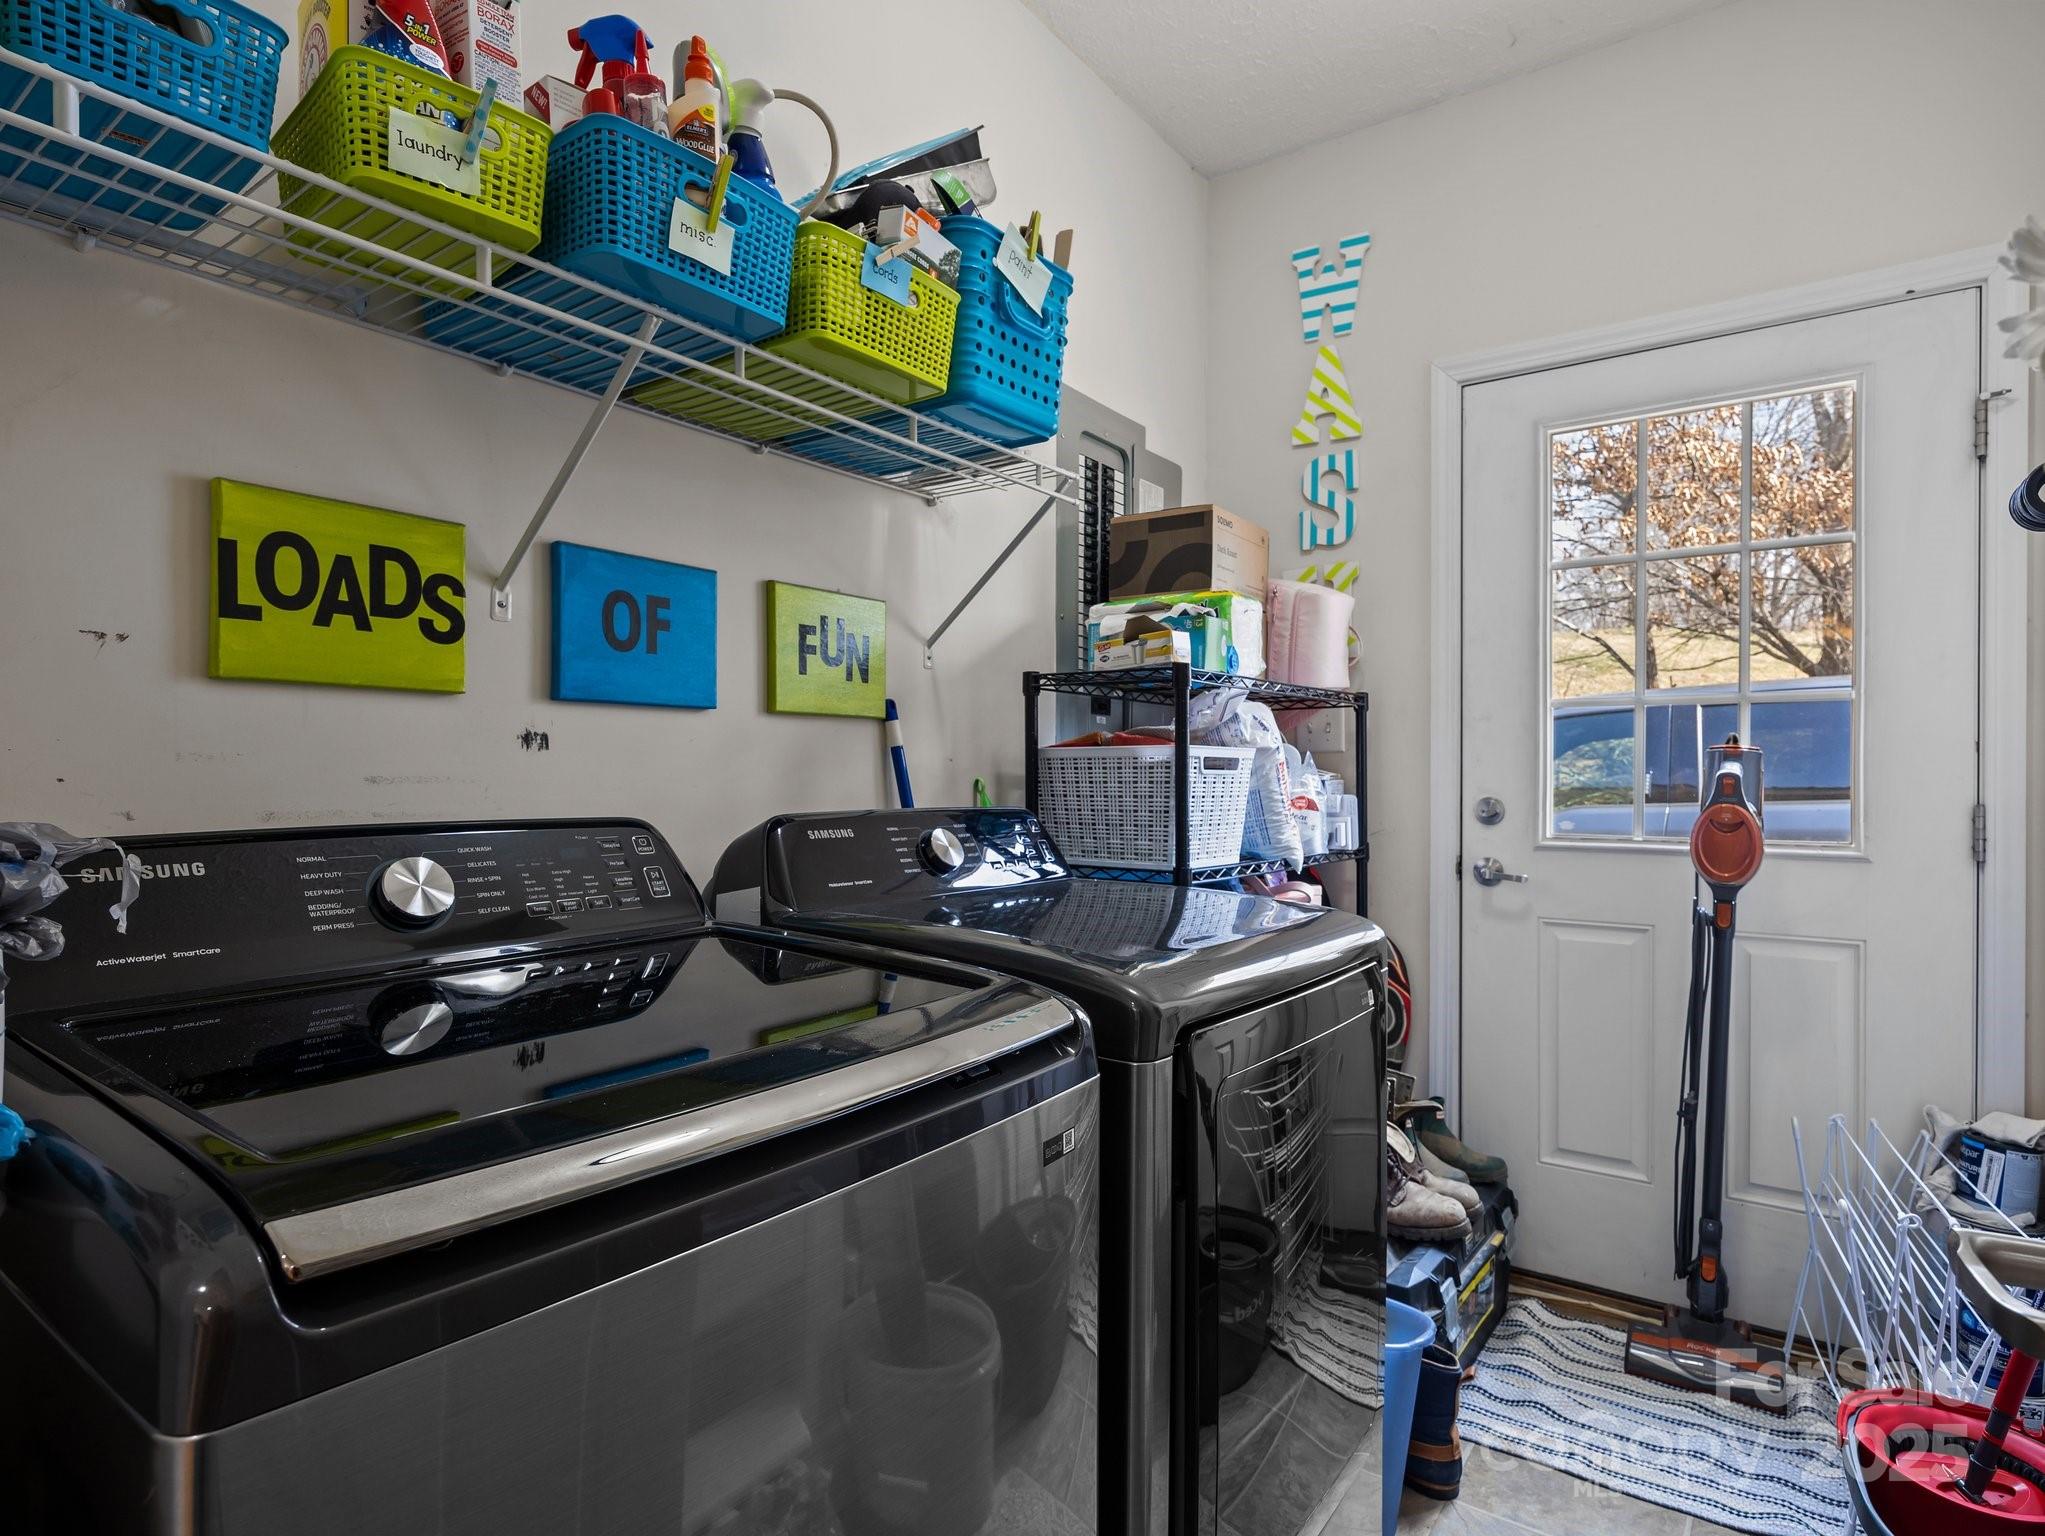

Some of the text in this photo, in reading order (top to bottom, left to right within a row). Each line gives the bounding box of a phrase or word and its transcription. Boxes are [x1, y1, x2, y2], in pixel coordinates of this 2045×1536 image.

[477, 6, 515, 33] BORAX
[407, 26, 437, 45] POWER
[484, 26, 510, 43] BOOSTER
[531, 86, 548, 109] NEW!
[396, 129, 462, 171] laundry
[698, 141, 715, 154] GLUE
[680, 222, 717, 248] misc.
[1008, 250, 1033, 279] paint
[872, 265, 898, 285] cords
[217, 530, 467, 644] LOADS
[601, 589, 671, 655] OF
[798, 614, 870, 684] FUN
[807, 828, 855, 840] SAMSUNG
[300, 872, 323, 880] HEAVY
[307, 902, 342, 911] BEDDING/
[309, 908, 356, 917] WATERPROOF
[312, 924, 333, 932] PERM
[96, 947, 221, 967] ActiveWaterjet SmartCare
